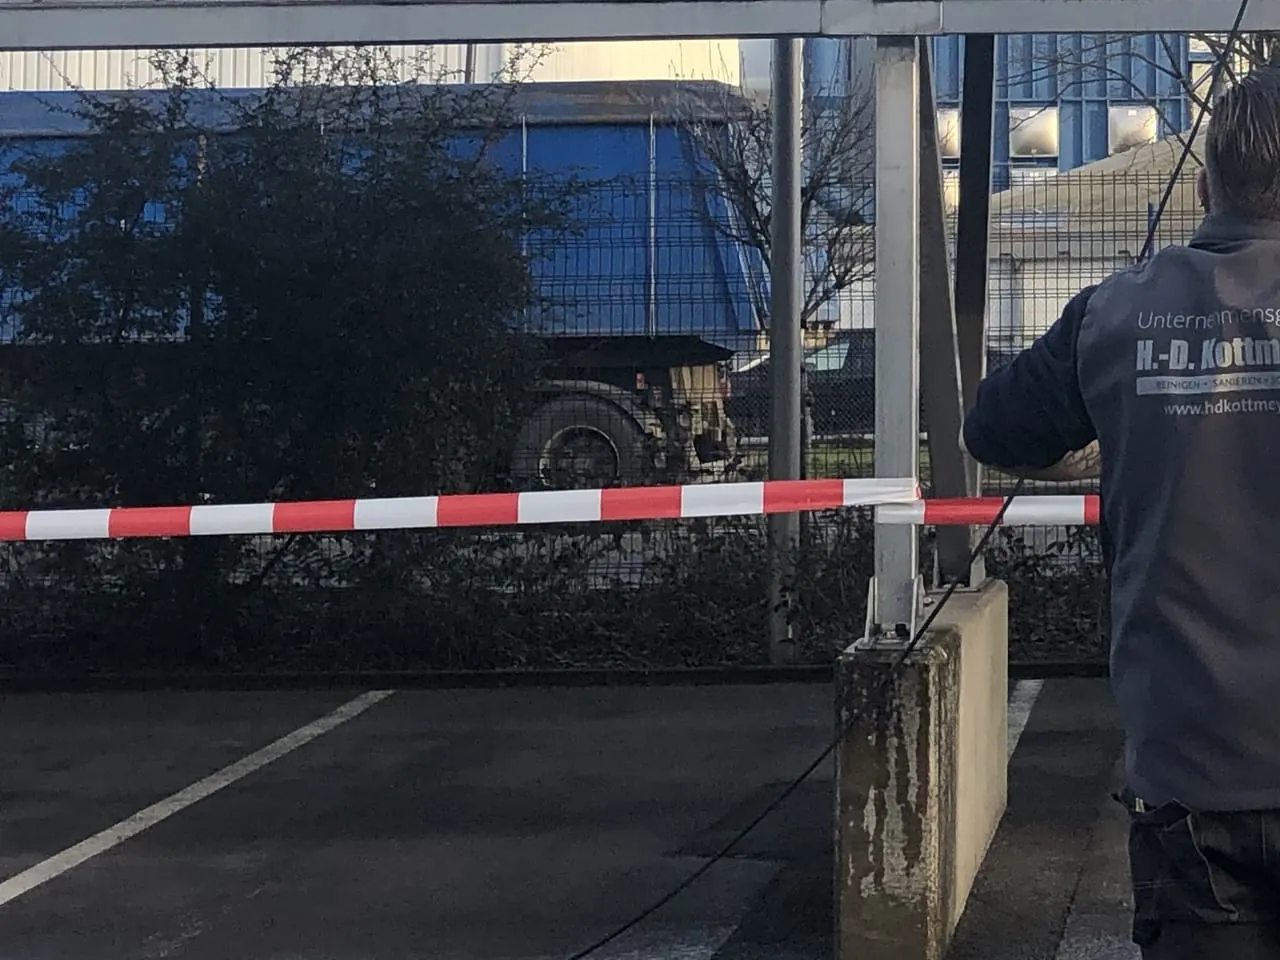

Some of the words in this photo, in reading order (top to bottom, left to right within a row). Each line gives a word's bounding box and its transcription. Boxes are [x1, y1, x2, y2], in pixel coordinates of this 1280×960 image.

[1135, 339, 1195, 371] H.-D.
[1155, 380, 1200, 390] REINIGEN
[1212, 376, 1262, 387] SANIEREN
